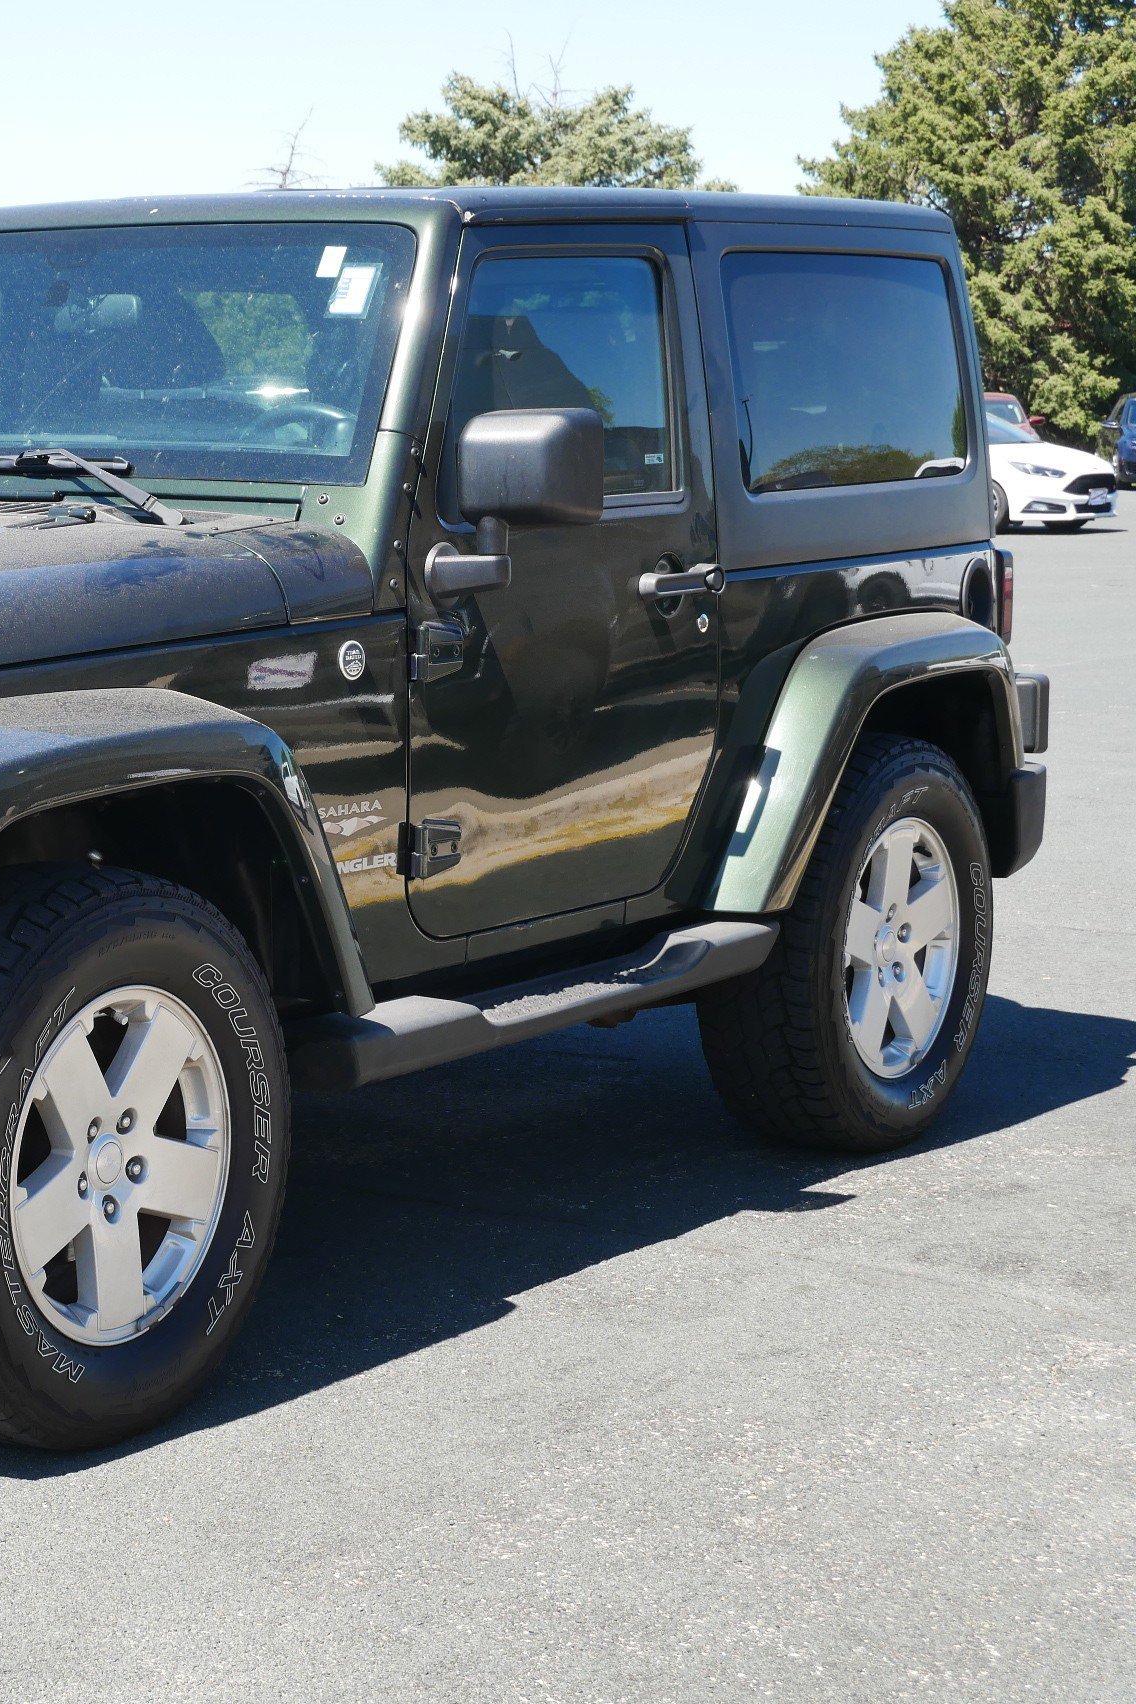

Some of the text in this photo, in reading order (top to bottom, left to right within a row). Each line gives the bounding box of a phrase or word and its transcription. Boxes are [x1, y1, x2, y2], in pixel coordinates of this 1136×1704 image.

[318, 799, 383, 820] SAHARA
[336, 852, 398, 875] NGLER
[953, 861, 988, 1054] COURSER
[907, 1058, 947, 1112] AXT
[190, 961, 272, 1337] COURSER AXT
